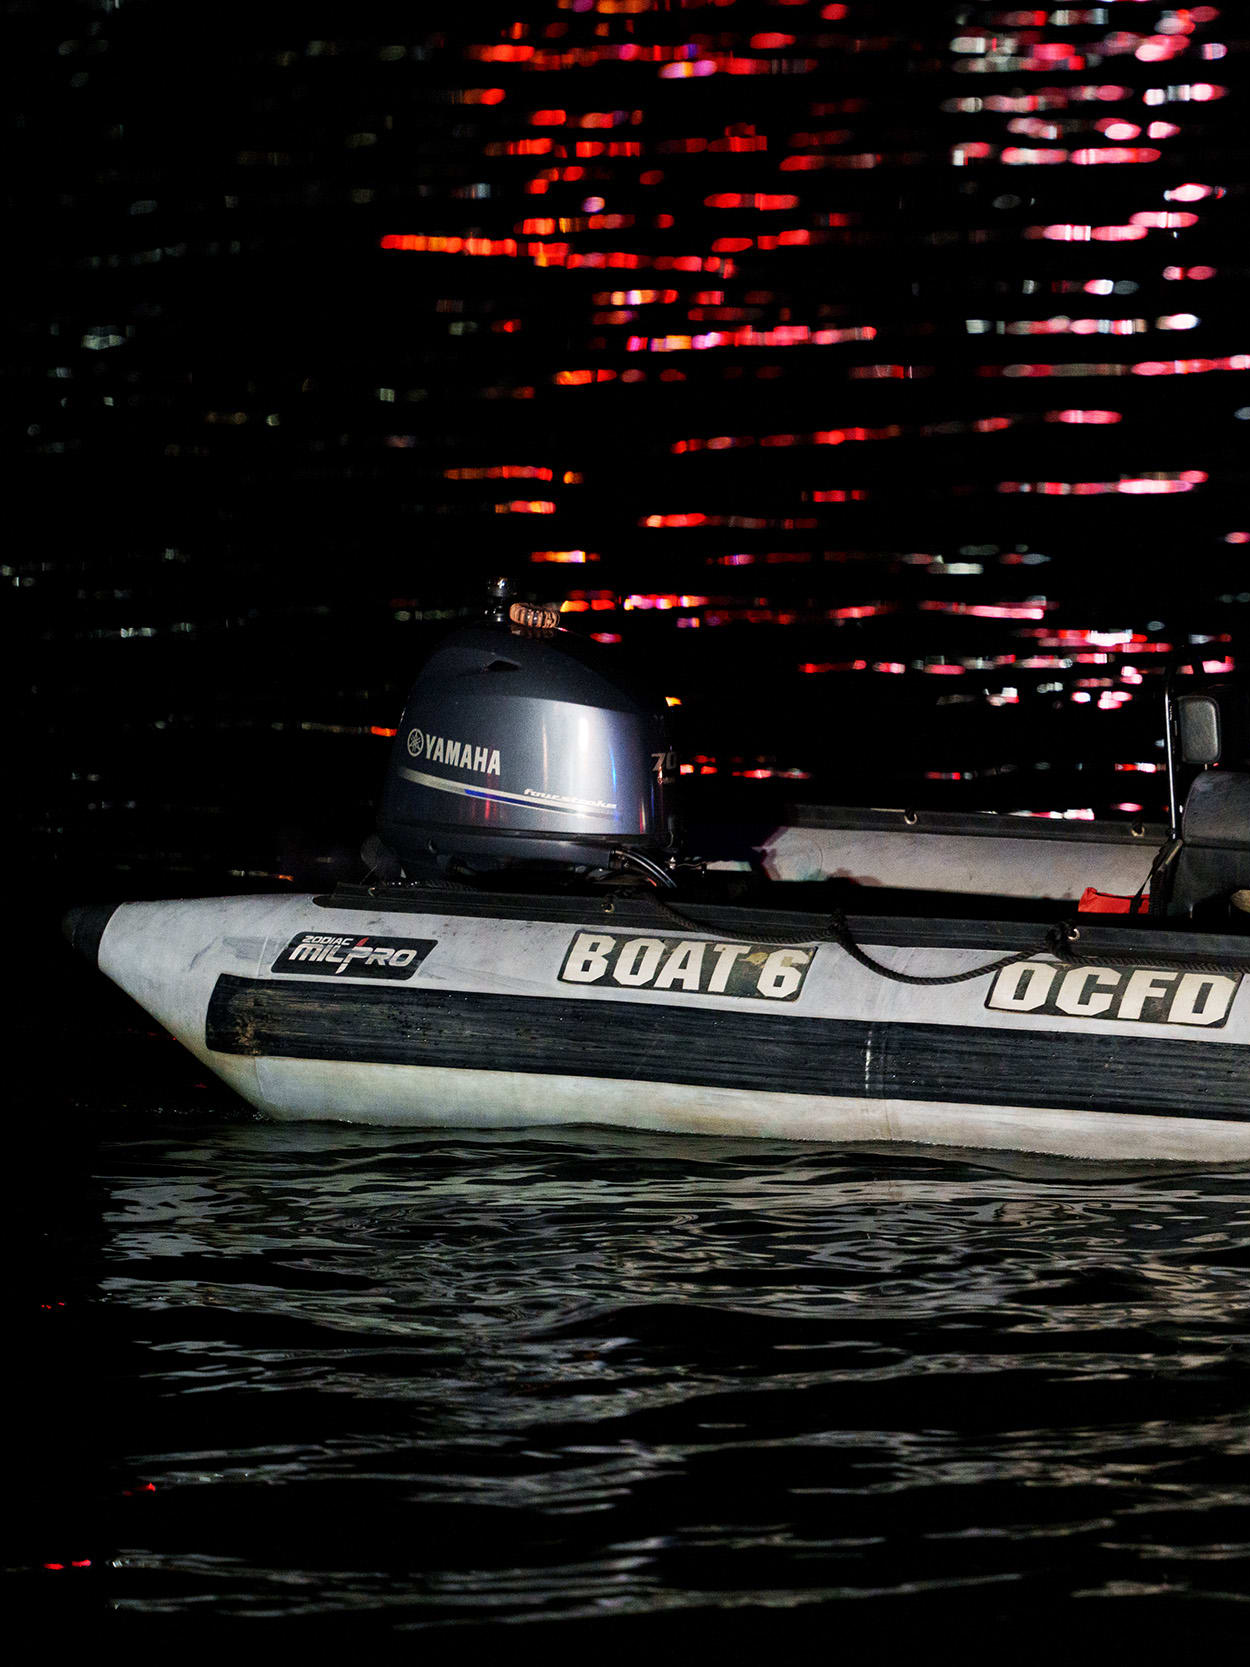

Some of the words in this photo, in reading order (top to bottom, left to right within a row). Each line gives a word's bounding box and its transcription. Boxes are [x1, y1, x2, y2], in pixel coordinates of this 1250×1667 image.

[425, 734, 501, 776] YAMAHA
[302, 935, 354, 946] ZODIAC
[562, 933, 751, 993] BOAT
[756, 949, 809, 998] 6
[988, 961, 1237, 1025] OCFD
